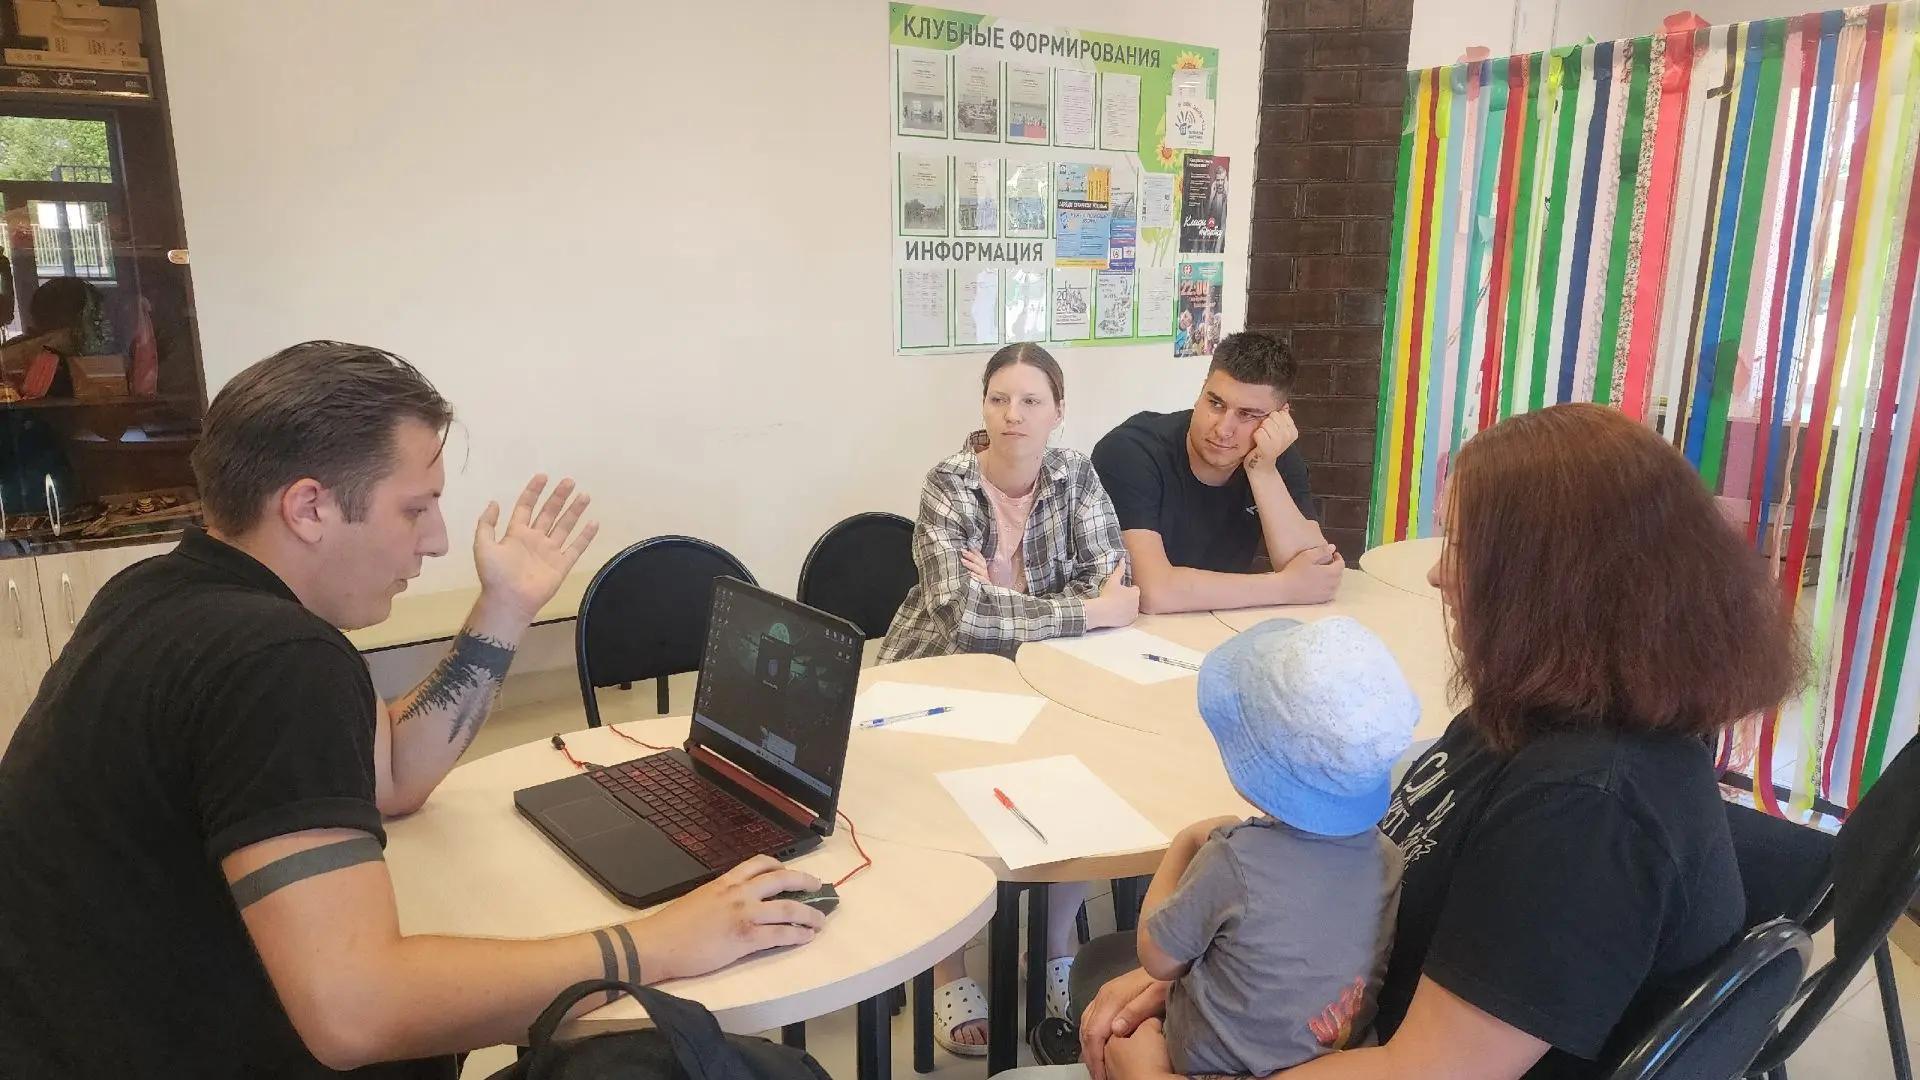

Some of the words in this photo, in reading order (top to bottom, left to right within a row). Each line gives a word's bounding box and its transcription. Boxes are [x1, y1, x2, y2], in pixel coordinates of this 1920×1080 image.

[903, 14, 1005, 49] КЛУБНЫЕ
[1009, 30, 1161, 69] ФОРМИРОВАНИЯ
[905, 241, 1043, 265] ИНФОРМАЦИЯ
